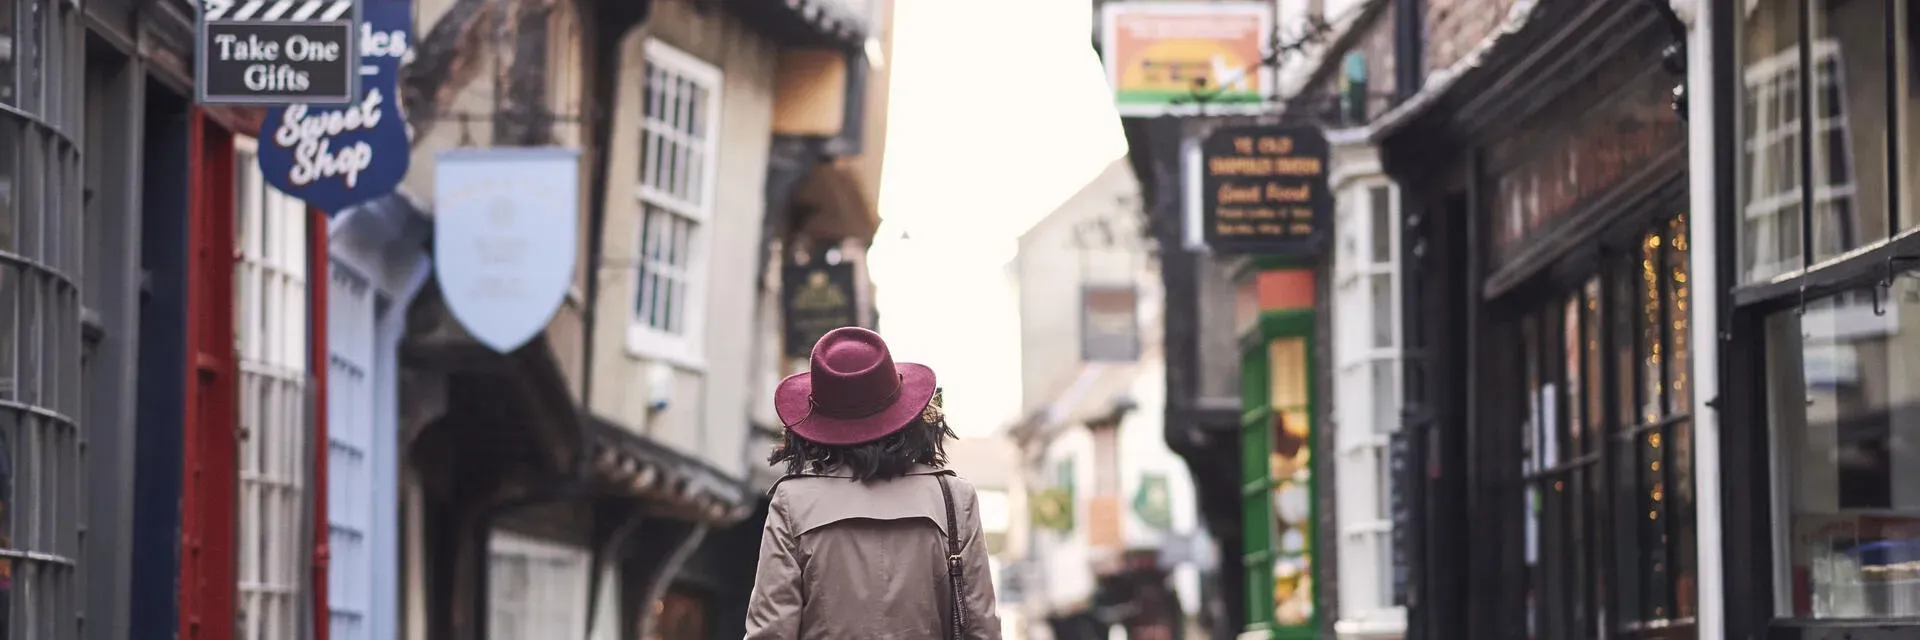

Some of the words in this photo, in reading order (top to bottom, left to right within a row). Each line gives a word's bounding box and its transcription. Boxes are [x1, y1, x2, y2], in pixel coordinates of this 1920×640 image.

[214, 34, 279, 61] Take
[285, 35, 340, 62] One
[243, 64, 310, 91] Gifts
[275, 88, 383, 147] Sweet
[289, 138, 373, 188] Shop
